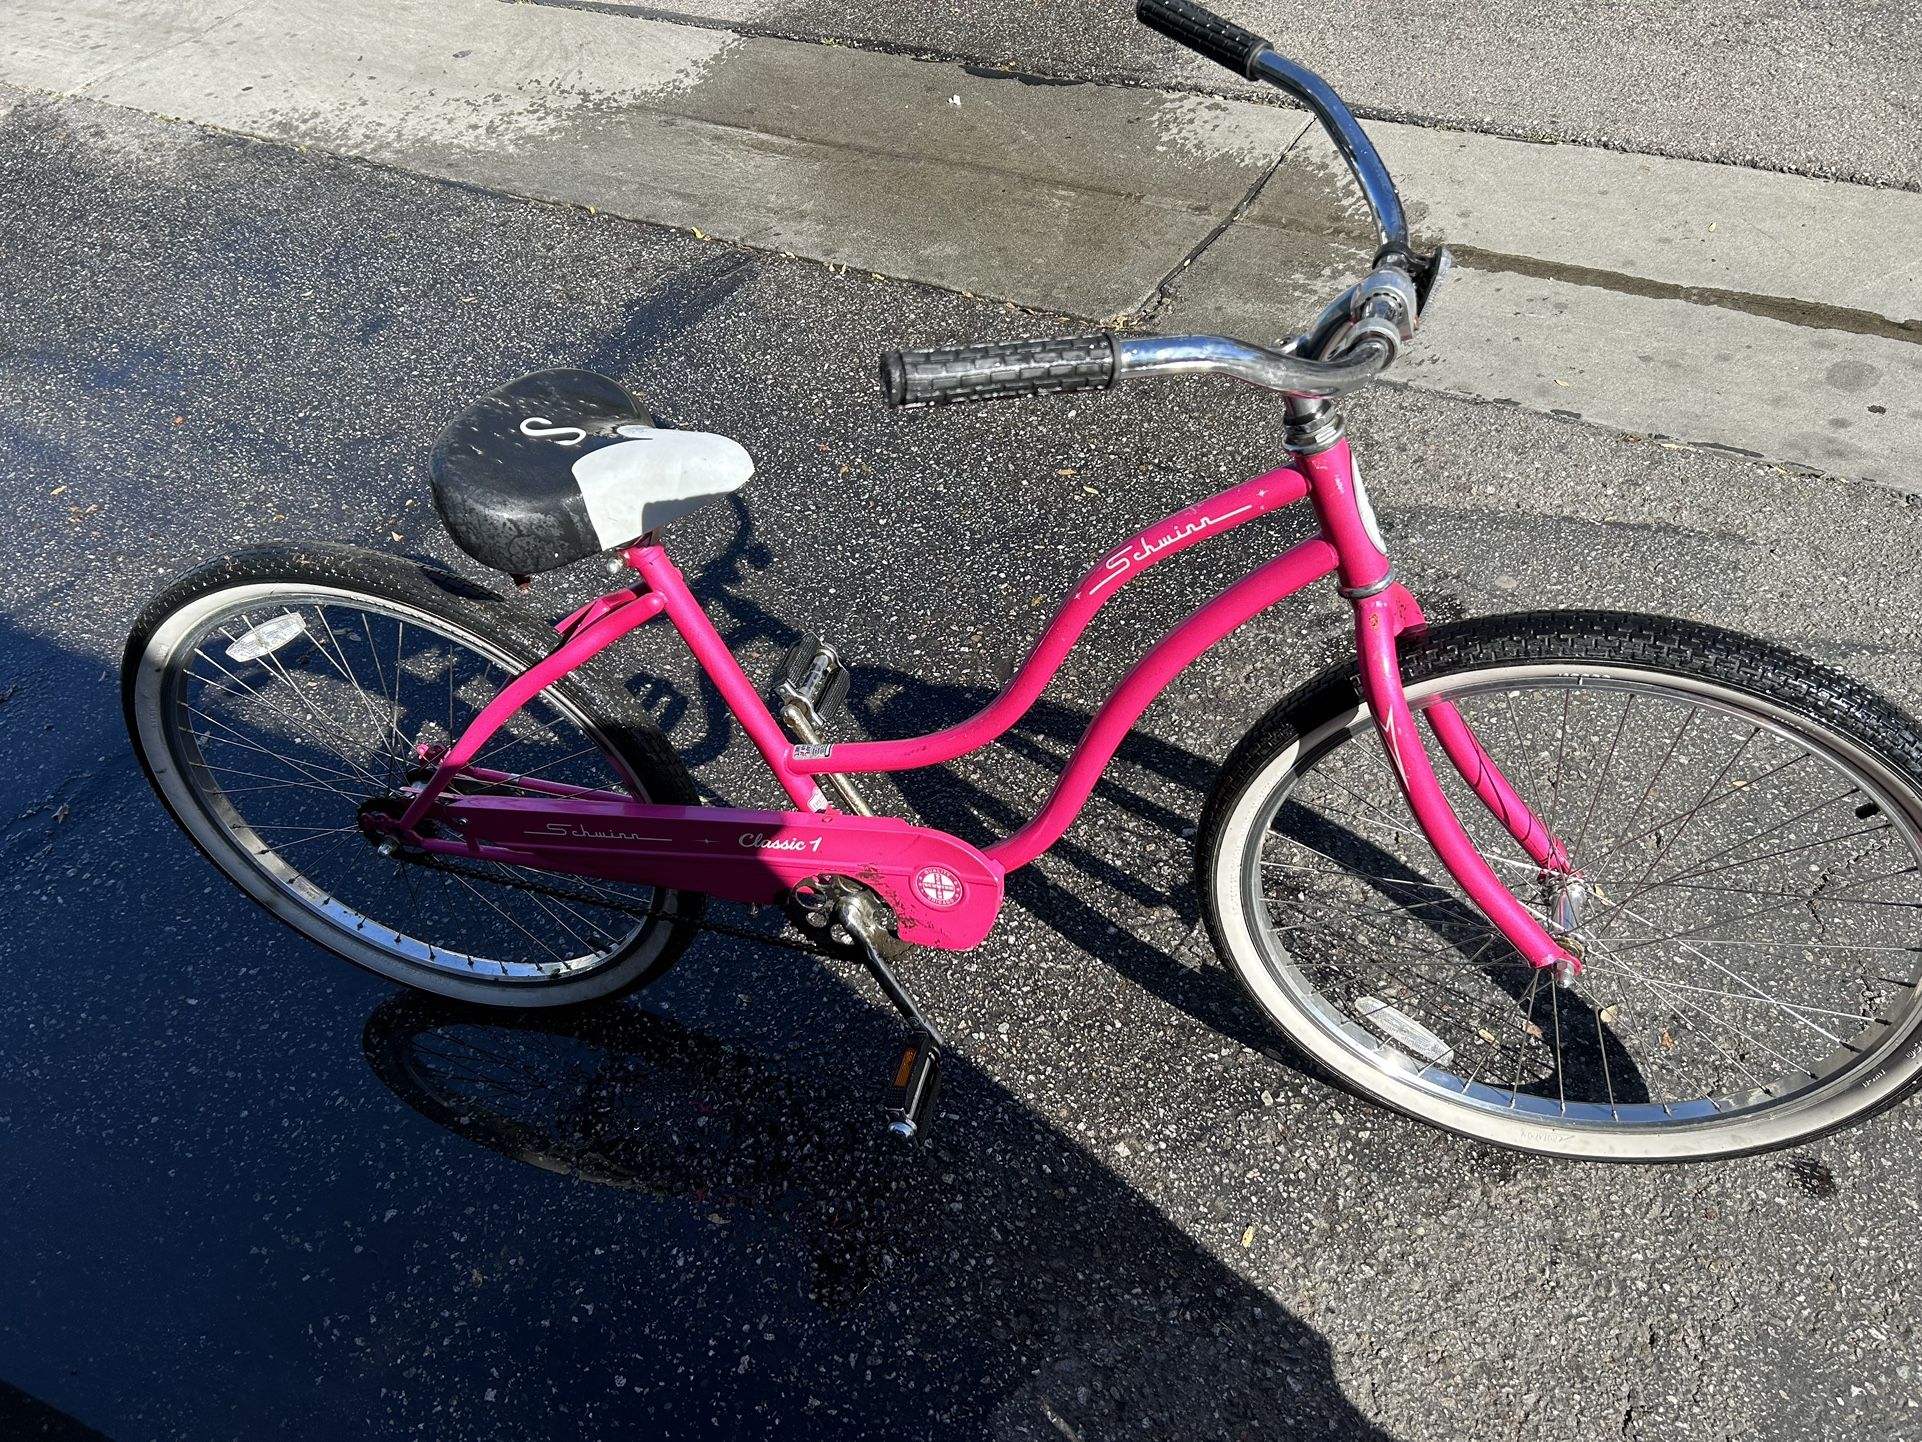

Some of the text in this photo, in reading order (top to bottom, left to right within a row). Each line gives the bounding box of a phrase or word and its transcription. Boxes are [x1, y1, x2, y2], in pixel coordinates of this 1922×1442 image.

[519, 416, 588, 446] S
[1088, 504, 1253, 596] Schwinn
[523, 823, 673, 842] Schwinn
[738, 832, 823, 852] Classic 1
